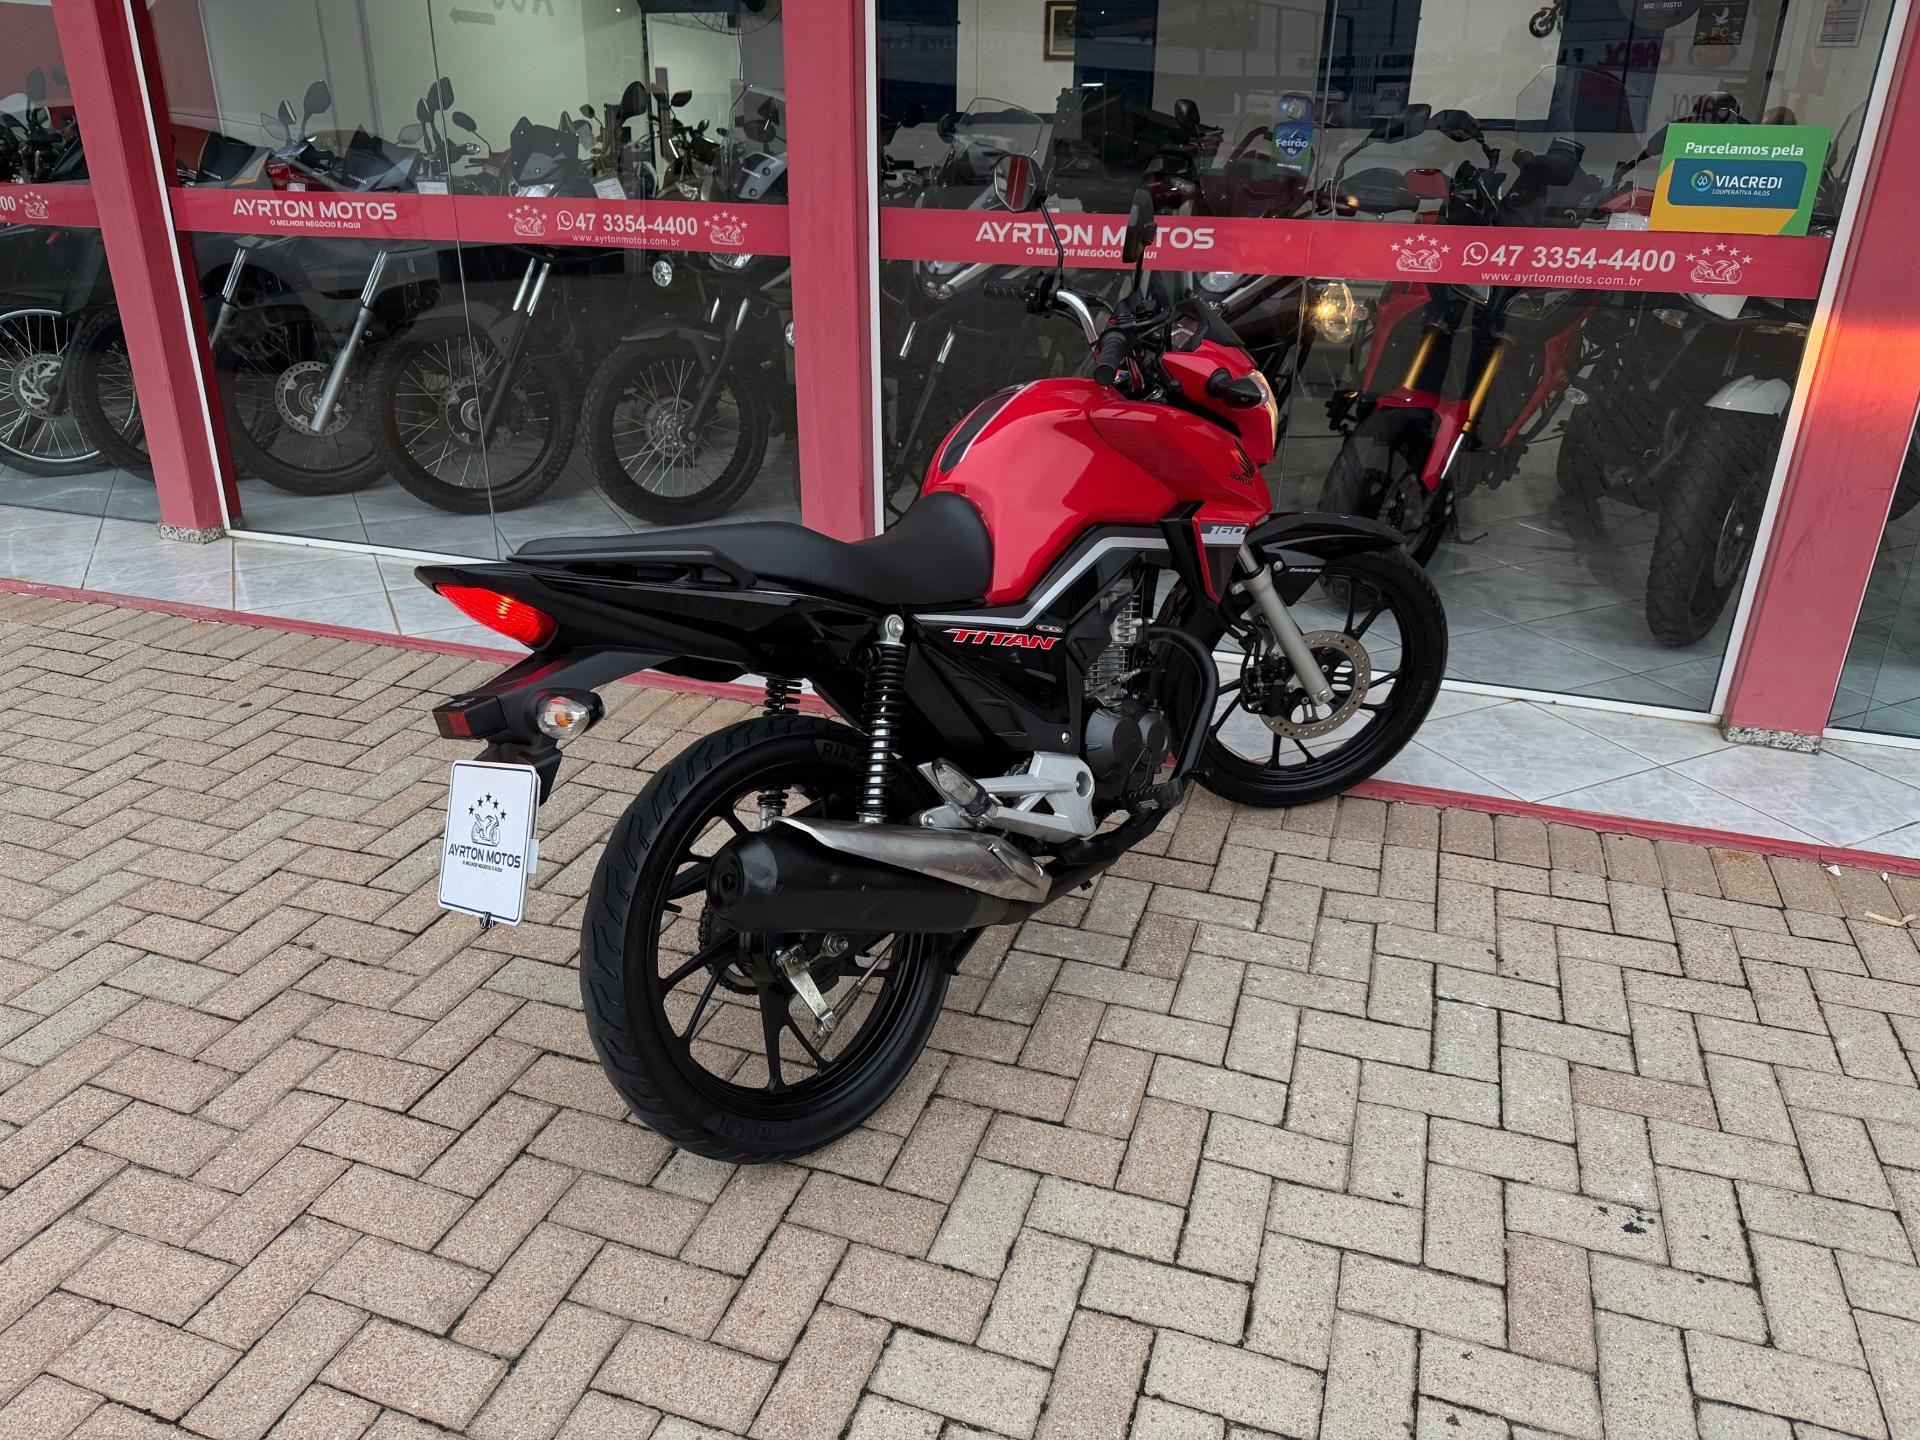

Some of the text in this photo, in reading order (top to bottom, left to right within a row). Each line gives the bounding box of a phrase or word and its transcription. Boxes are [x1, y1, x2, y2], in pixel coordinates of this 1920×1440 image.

[1275, 138, 1309, 148] Feirão
[1684, 141, 1804, 158] Parcelamos pela
[1715, 175, 1783, 190] VIACREDI
[232, 198, 398, 221] AYRTON MOTOS
[305, 219, 336, 229] NEGÓCIO
[337, 220, 342, 228] É
[343, 221, 361, 229] AQUI
[575, 213, 698, 236] 47 3354-4400
[572, 234, 680, 247] www.ayrtonmotos.com.br
[975, 221, 1215, 249] AYRTON MTOS
[1026, 247, 1034, 255] O
[1077, 247, 1121, 258] NEGÓCIO
[1490, 245, 1676, 273] 47 3354-4400
[1481, 272, 1643, 286] www.ayrtonmotos.com.br
[1211, 525, 1247, 535] 160
[942, 628, 1062, 650] TITAN
[448, 843, 521, 869] AYRTON MOTOS
